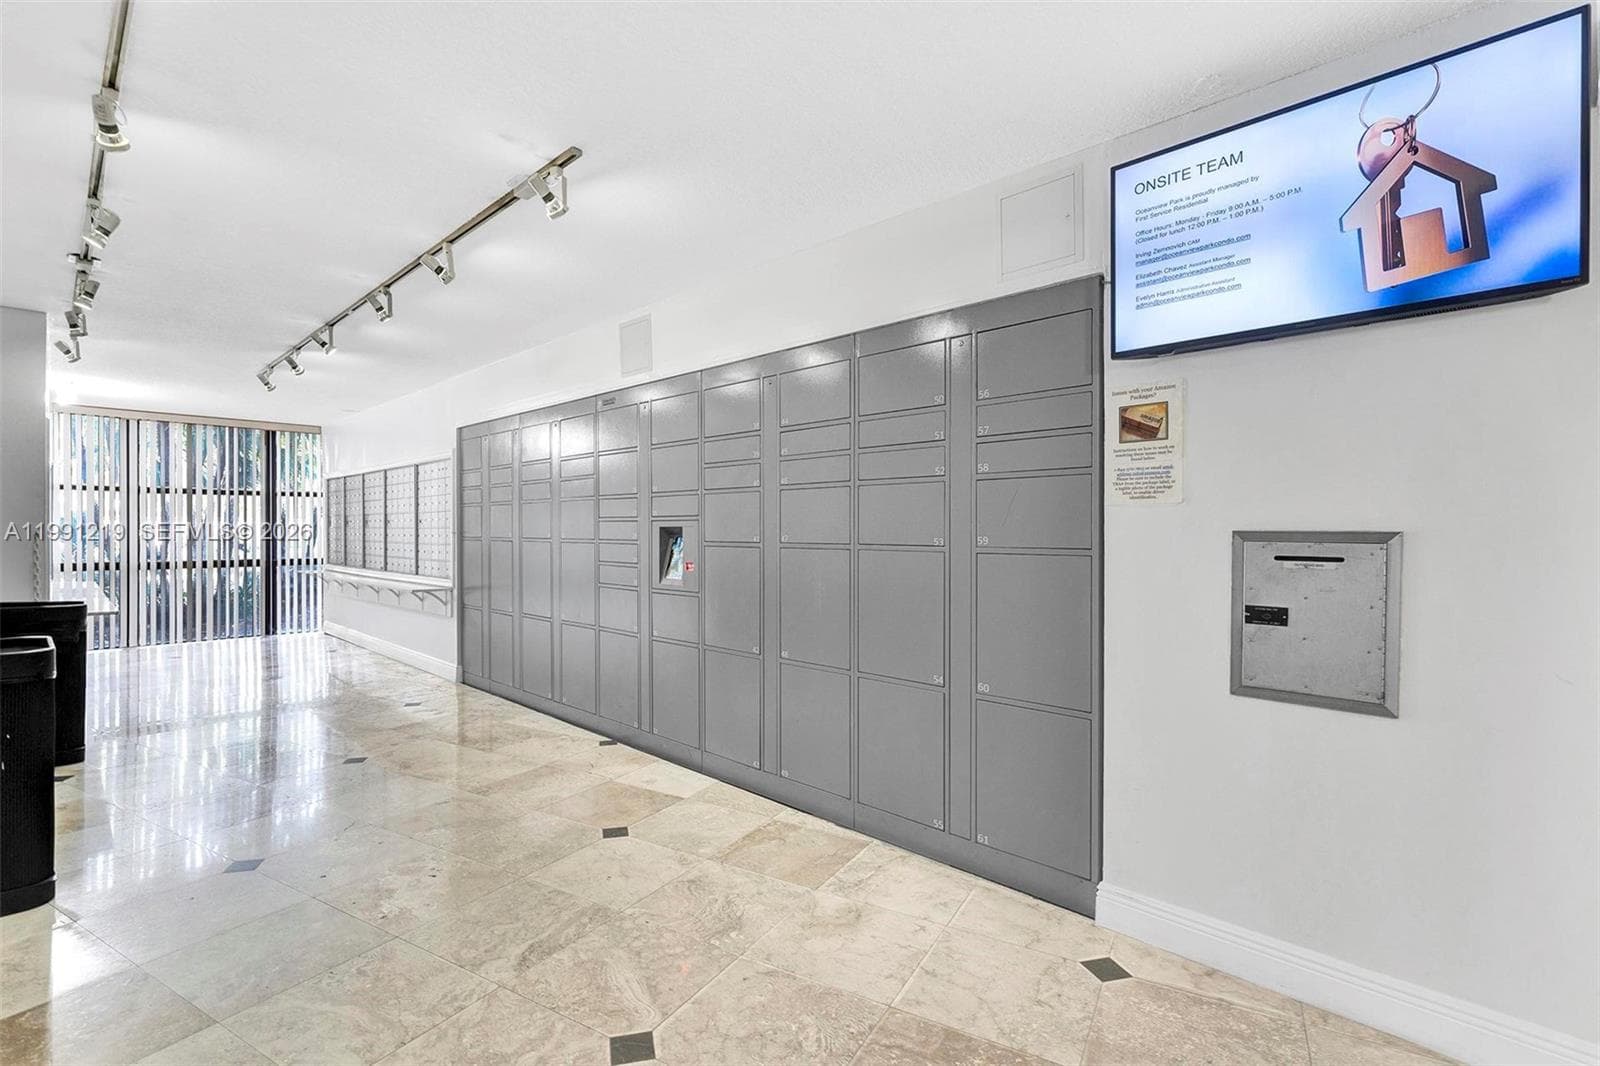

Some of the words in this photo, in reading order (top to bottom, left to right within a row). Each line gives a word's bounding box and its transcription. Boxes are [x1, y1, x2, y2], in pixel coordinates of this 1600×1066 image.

[1135, 167, 1192, 195] ONSITE
[1196, 150, 1244, 175] TEAM
[1136, 203, 1168, 215] Oceanview
[1170, 198, 1184, 206] Park
[1192, 188, 1216, 201] proudly
[1217, 178, 1249, 192] managed
[1136, 214, 1149, 223] First
[1150, 209, 1172, 219] Service
[1173, 197, 1209, 212] Residential
[1136, 228, 1152, 238] Office
[1154, 223, 1173, 234] Hours:
[1175, 215, 1200, 227] Monday
[1206, 208, 1227, 219] Friday
[1270, 190, 1286, 201] 5:00
[1136, 233, 1158, 245] (Closed
[1159, 230, 1168, 238] for
[1169, 226, 1186, 236] lunch
[1188, 220, 1206, 231] 12:00
[1230, 209, 1244, 220] 1:00
[1187, 238, 1201, 246] CAM
[1136, 269, 1163, 280] Elizabeth
[1163, 264, 1188, 275] Chavez
[1136, 293, 1156, 304] Evelyn
[978, 388, 990, 399] 56
[1141, 386, 1154, 394] your
[935, 431, 945, 440] 51
[978, 425, 990, 435] 57
[935, 466, 945, 476] 52
[978, 462, 990, 472] 58
[934, 537, 944, 546] 53
[978, 535, 989, 545] 59
[933, 674, 944, 685] 54
[977, 682, 990, 693] 60
[933, 818, 944, 830] 55
[977, 833, 989, 845] 61
